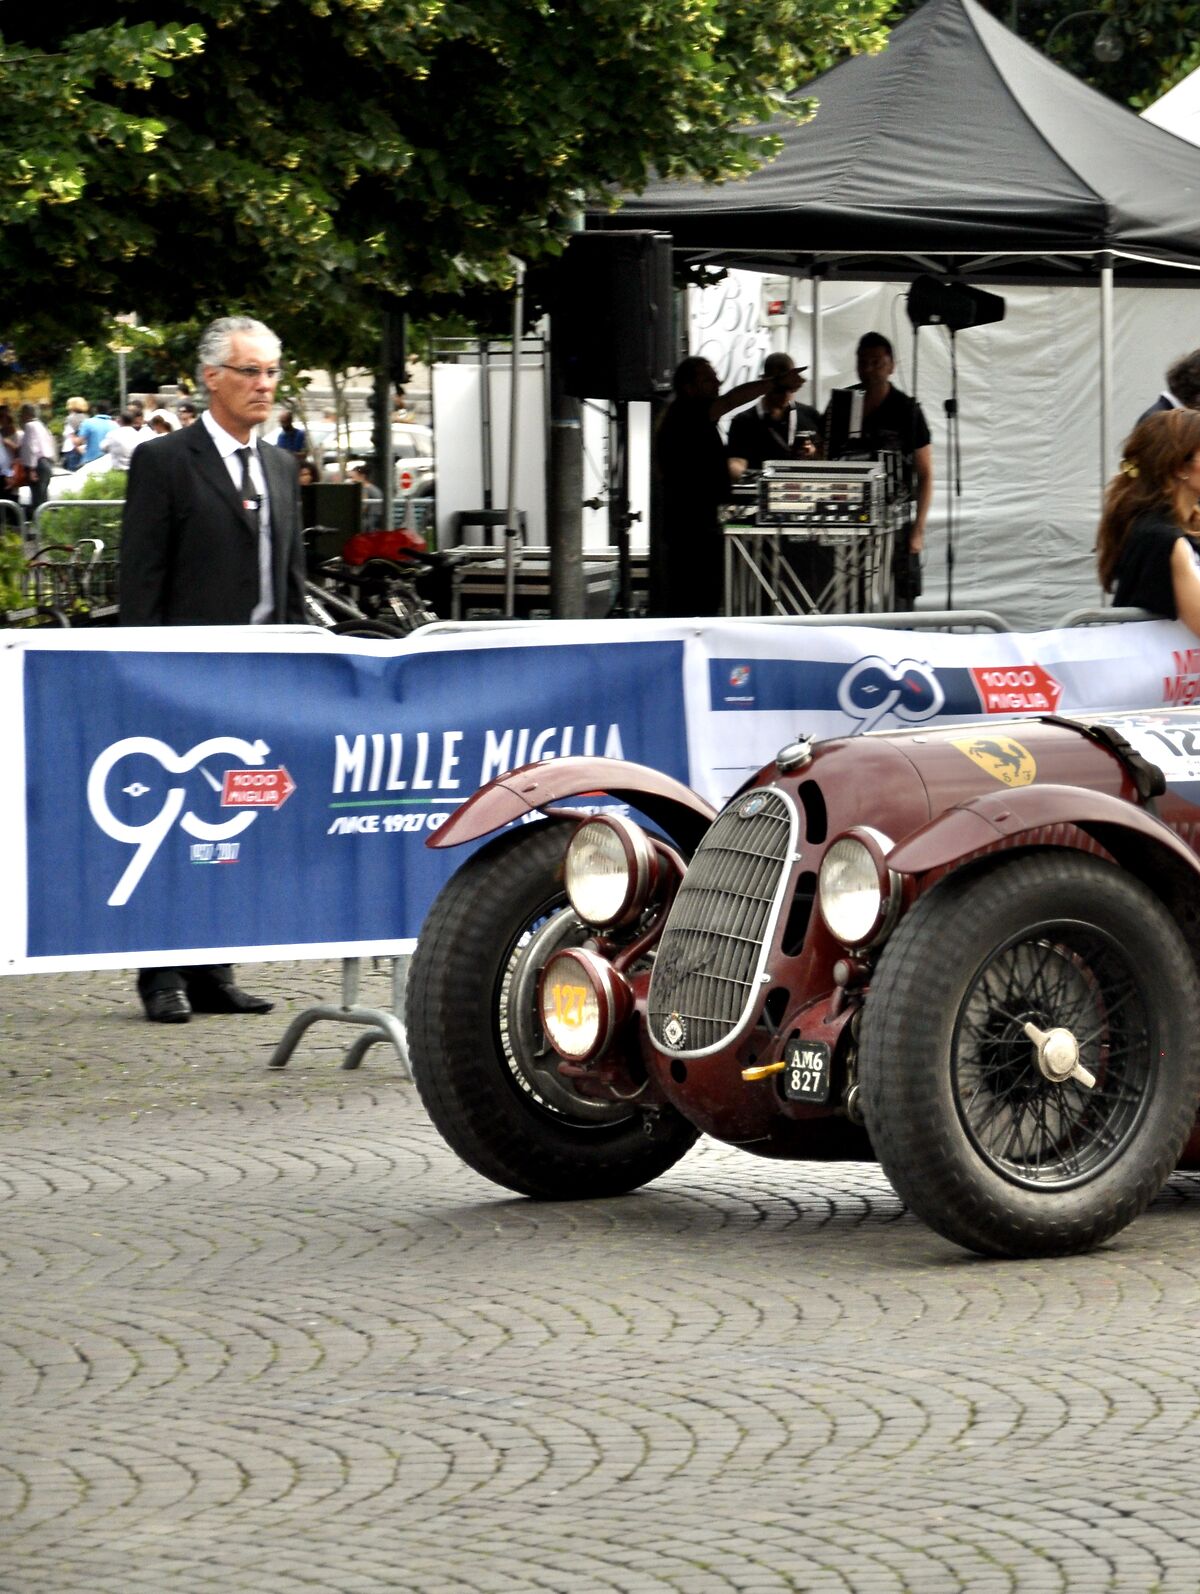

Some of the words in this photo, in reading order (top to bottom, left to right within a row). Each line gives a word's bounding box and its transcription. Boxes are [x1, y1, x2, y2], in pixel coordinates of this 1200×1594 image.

[982, 671, 1037, 687] 1000
[987, 692, 1051, 709] MIGLIA
[332, 730, 464, 794] MILLE
[232, 774, 279, 787] 1000
[227, 790, 280, 803] MIGLIA
[382, 813, 428, 833] 1927
[551, 983, 587, 1026] 127
[791, 1050, 824, 1071] AM6
[791, 1069, 822, 1092] 827
